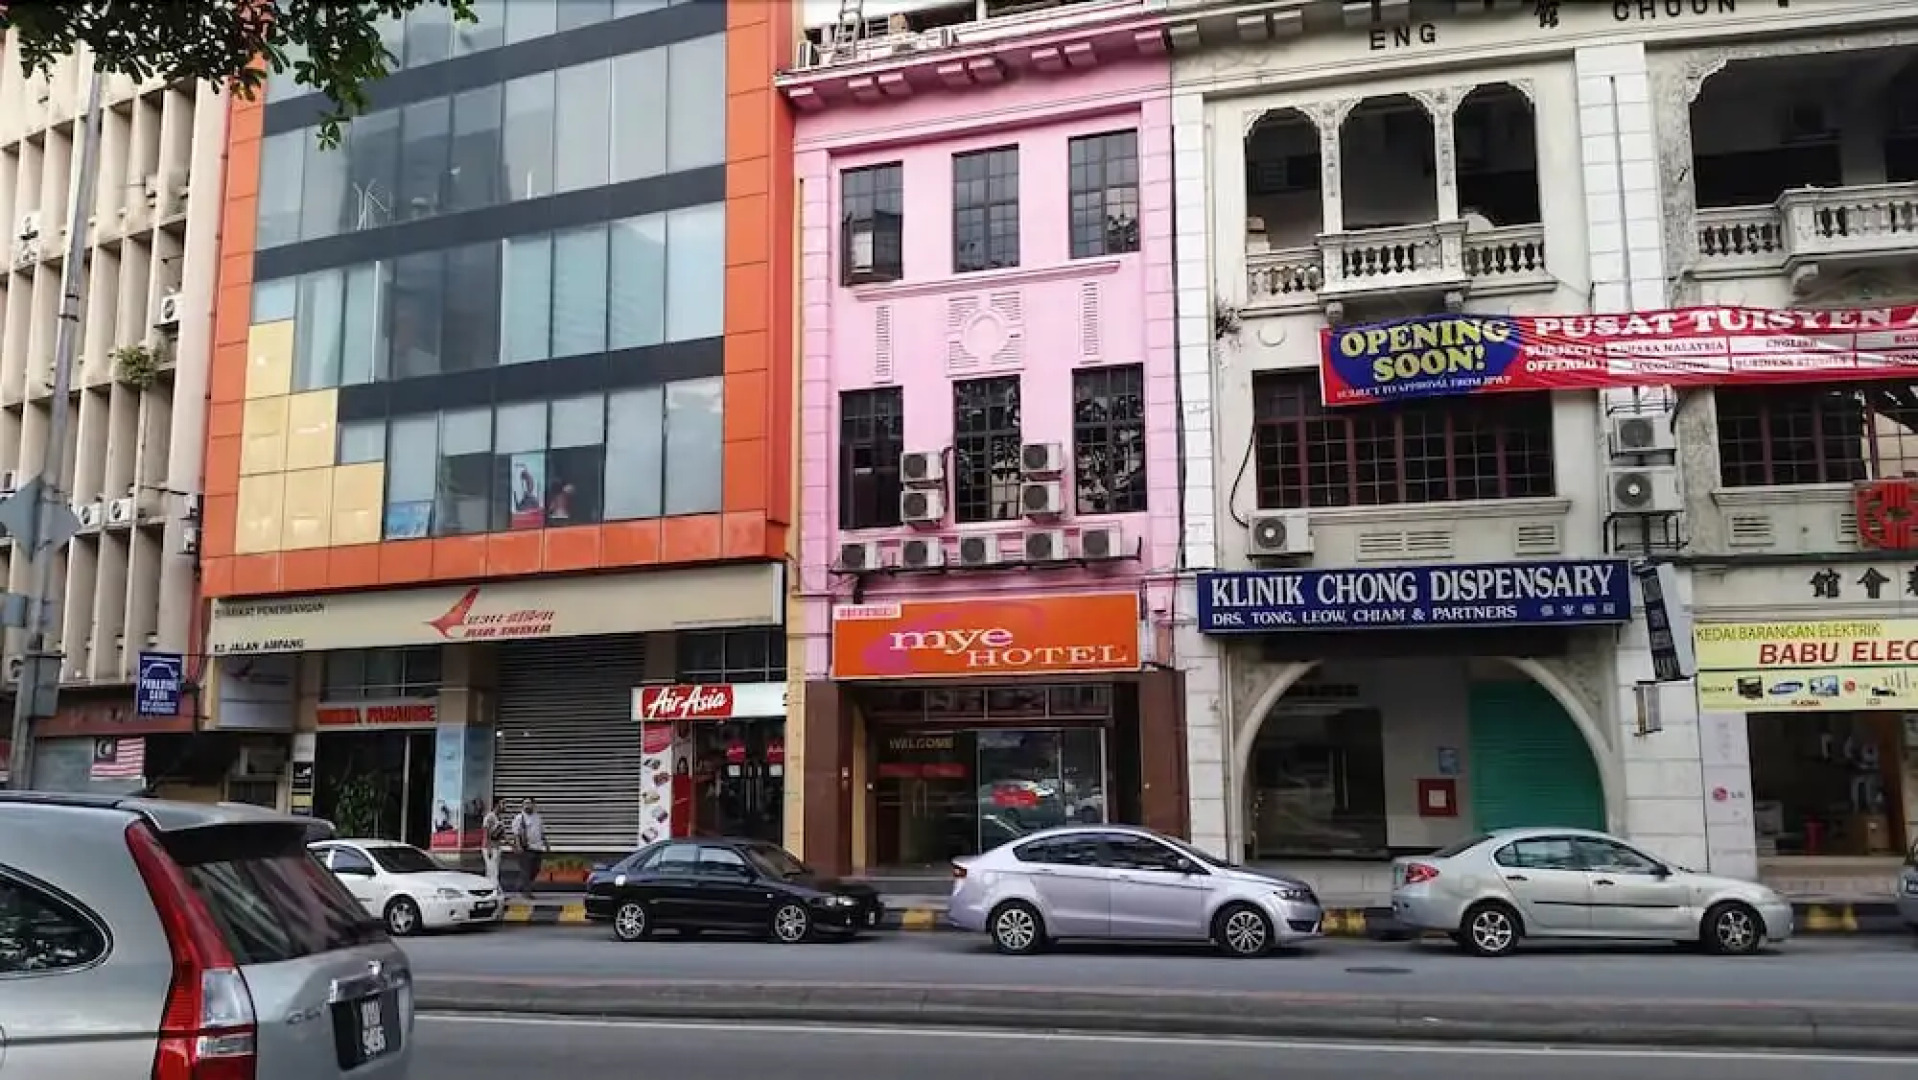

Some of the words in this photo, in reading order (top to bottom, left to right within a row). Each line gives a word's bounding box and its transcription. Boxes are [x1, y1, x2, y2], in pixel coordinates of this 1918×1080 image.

[1370, 23, 1436, 50] ENG
[1534, 315, 1677, 337] PUSAT
[1691, 309, 1891, 331] TUISYEN
[1340, 319, 1511, 358] OPENING
[1373, 344, 1485, 382] SOON!
[1212, 574, 1304, 607] KLINIK
[1317, 571, 1418, 604] CHONG
[1429, 564, 1613, 601] DISPENSARY
[1212, 612, 1246, 626] DRS.
[1353, 608, 1406, 622] CHIAM
[1411, 607, 1426, 621] &
[1432, 605, 1518, 620] PARTNERS
[889, 627, 1014, 654] mye
[1739, 623, 1815, 640] BARANGAN
[1820, 623, 1881, 637] ELEKTRIK
[966, 645, 1127, 666] HOTEL
[1759, 642, 1839, 665] BABU
[1852, 640, 1918, 663] ELEC
